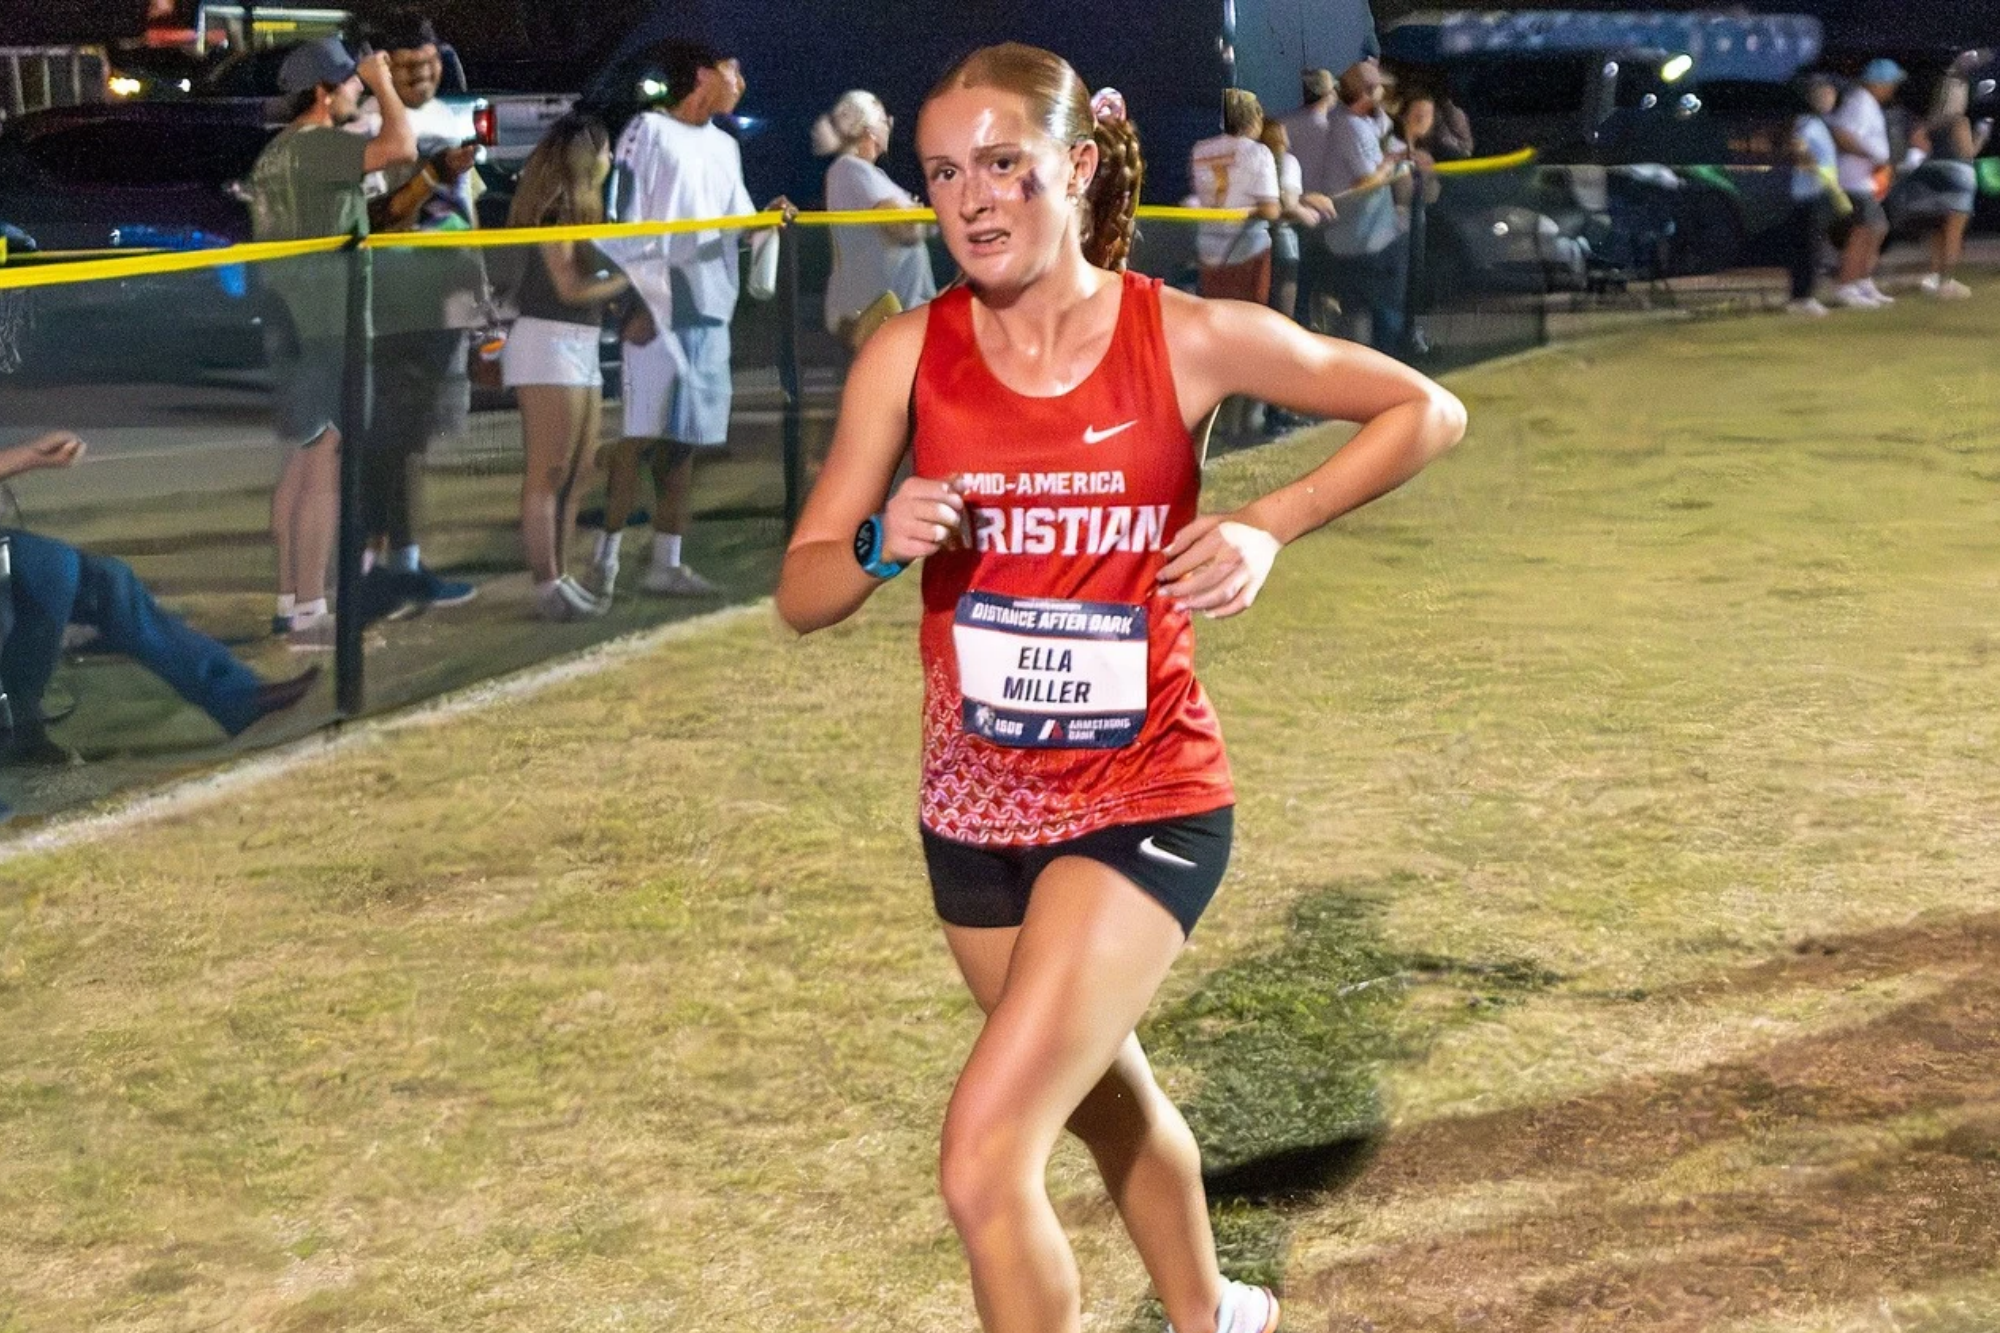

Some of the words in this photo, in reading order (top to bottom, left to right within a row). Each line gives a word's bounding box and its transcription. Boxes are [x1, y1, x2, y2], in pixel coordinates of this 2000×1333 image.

[963, 470, 1126, 496] MID-AMERICA
[974, 504, 1171, 556] RISTIAN
[971, 602, 1036, 629] DISTANCE
[1038, 611, 1087, 632] AFTER
[1089, 613, 1133, 635] DARK
[1017, 646, 1072, 673] ELLA
[1002, 676, 1091, 704] MILLER
